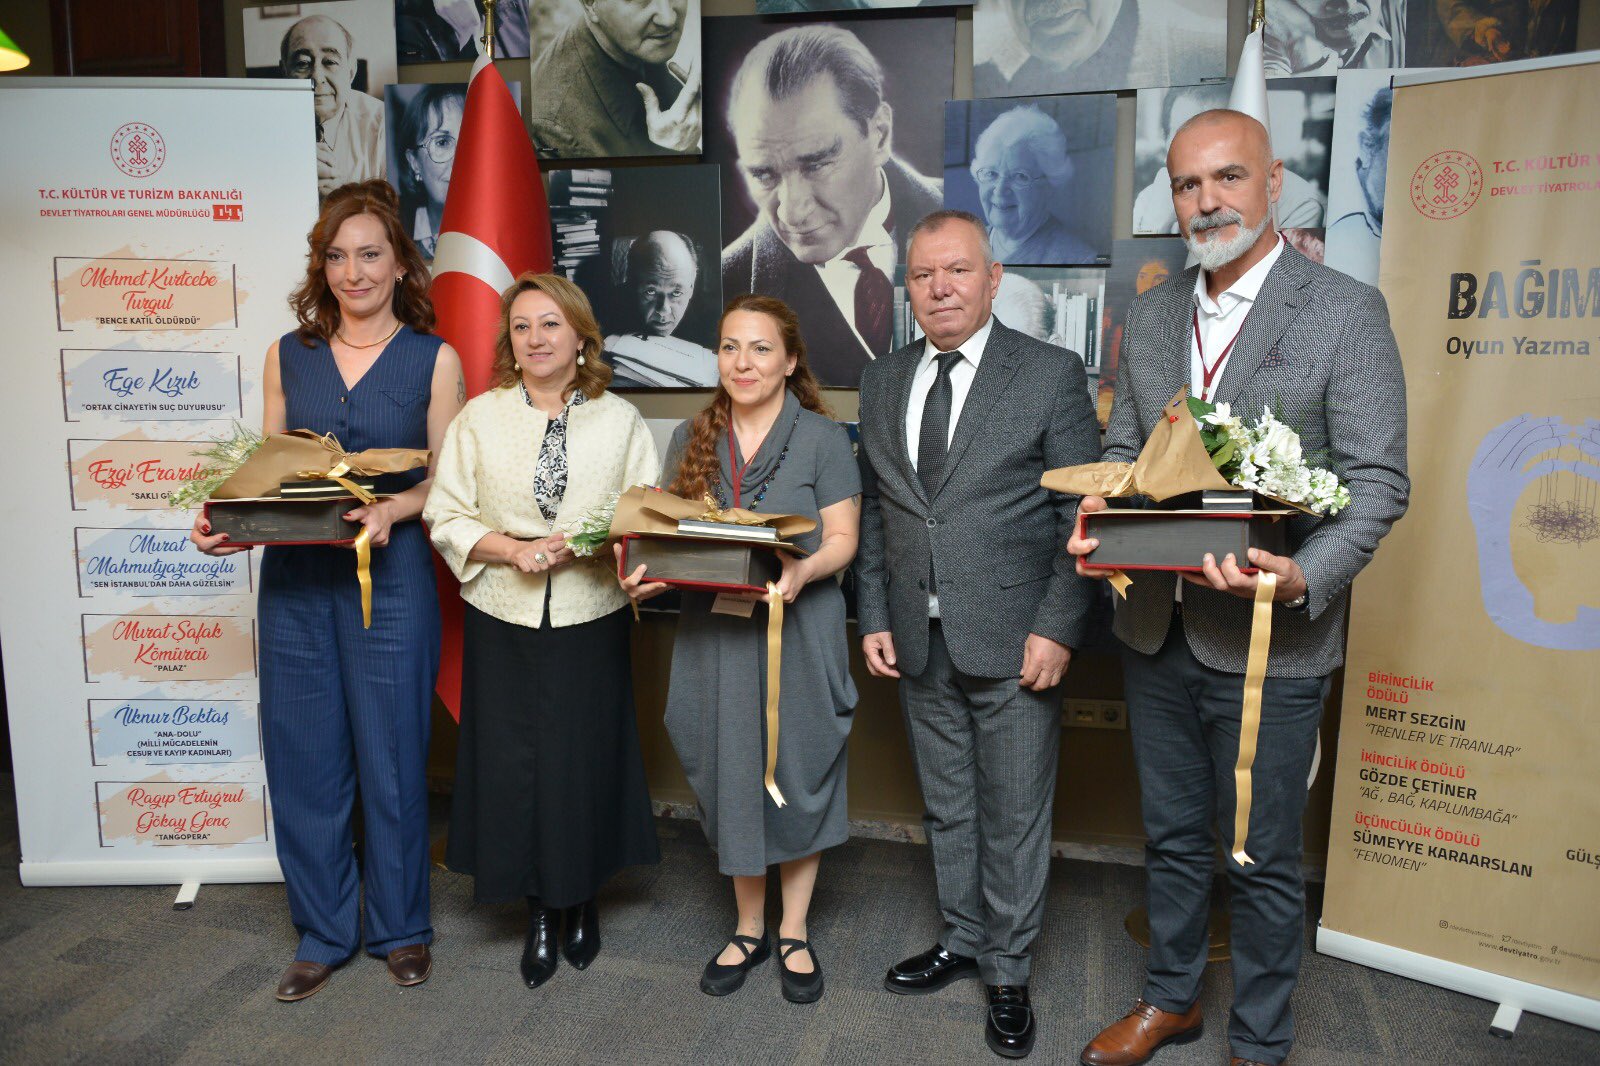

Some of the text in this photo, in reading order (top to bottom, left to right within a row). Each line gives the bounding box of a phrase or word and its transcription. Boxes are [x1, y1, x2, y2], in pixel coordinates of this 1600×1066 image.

[1493, 152, 1590, 173] T.C. KÜLTÜR
[39, 187, 243, 200] T.C. KÜLTÜR VE TURİZM BAKANLIĞI
[1491, 184, 1536, 196] DEVLET
[40, 209, 73, 217] DEVLET
[73, 208, 126, 218] TİYATROLARI
[127, 209, 154, 218] GENEL
[156, 208, 210, 218] MÜDÜRLÜĞÜ
[80, 267, 217, 290] Mehmet Kurtcebe
[122, 290, 174, 316] Turgul
[130, 315, 154, 325] KATİL
[1447, 336, 1590, 359] Oyun Yazma
[103, 367, 201, 398] Ege Kızık
[114, 402, 157, 411] CİNAYETİN
[159, 403, 176, 412] SUÇ
[88, 459, 134, 489] Ezgi
[129, 534, 190, 554] Murat
[86, 556, 236, 580] Mahmutyazıcıoğlu
[112, 619, 223, 644] Murat Şafak
[134, 643, 210, 665] Kömürcü
[1368, 671, 1434, 692] BİRİNCİLİK
[1367, 688, 1409, 704] ÖDÜLÜ
[114, 704, 230, 727] İlknur Bektaş
[1366, 705, 1466, 732] MERT SEZGİN
[137, 738, 218, 748] (MİLLİ MÜCADELENİN
[1429, 733, 1445, 746] VE
[127, 749, 152, 757] CESUR
[188, 749, 232, 757] KADINLARI)
[1361, 748, 1466, 779] İKİNCİLİK ÖDÜLÜ
[1359, 768, 1477, 801] GÖZDE ÇETİNER
[127, 787, 244, 809] Ragıp Ertuğrul
[136, 811, 230, 834] Gökay Genç
[1354, 811, 1480, 848] ÜÇÜNCÜLÜK ÖDÜLÜ
[1353, 830, 1533, 878] SÜMEYYE KARAARSLAN
